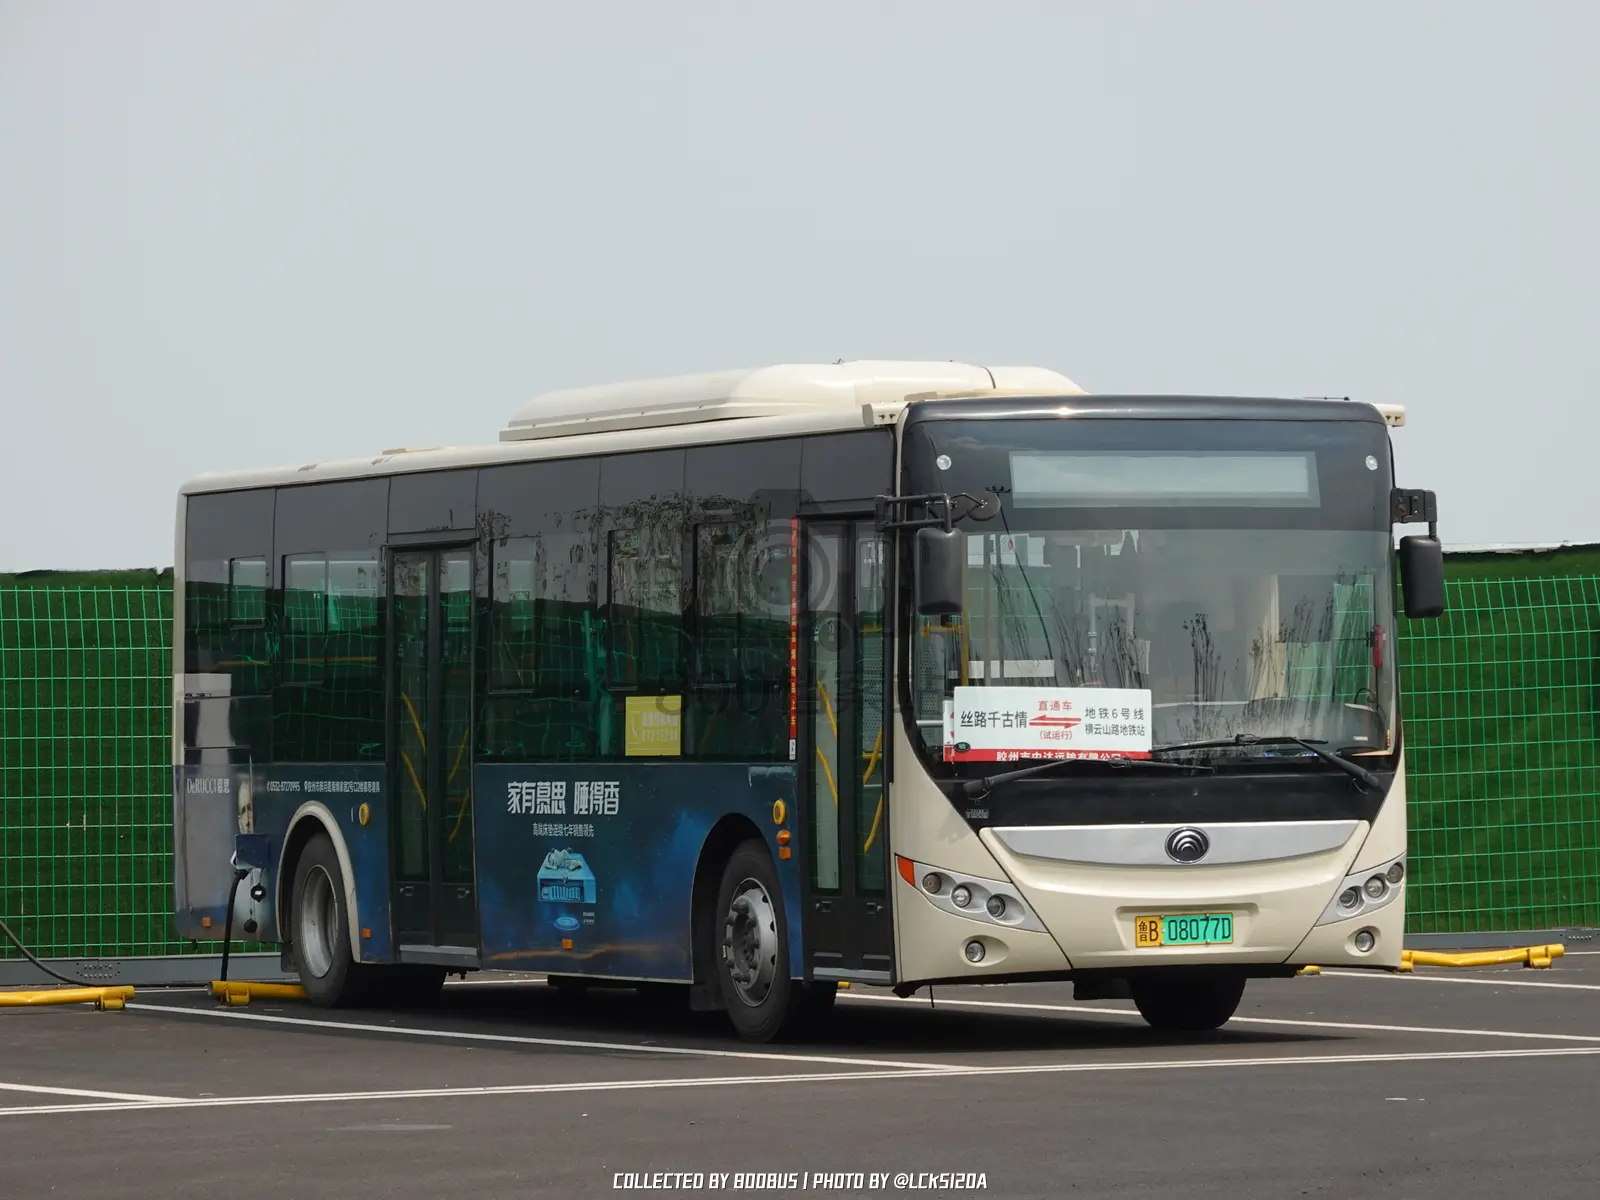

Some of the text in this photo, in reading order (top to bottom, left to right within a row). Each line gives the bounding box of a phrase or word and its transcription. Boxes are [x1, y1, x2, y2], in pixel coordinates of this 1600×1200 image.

[1037, 700, 1073, 711] 直通车
[960, 710, 1028, 729] 丝路千古情
[1084, 707, 1144, 720] 地铁6号线
[1084, 723, 1145, 737] 横云山路地铁站
[507, 781, 620, 815] 家有慕思 睡得香
